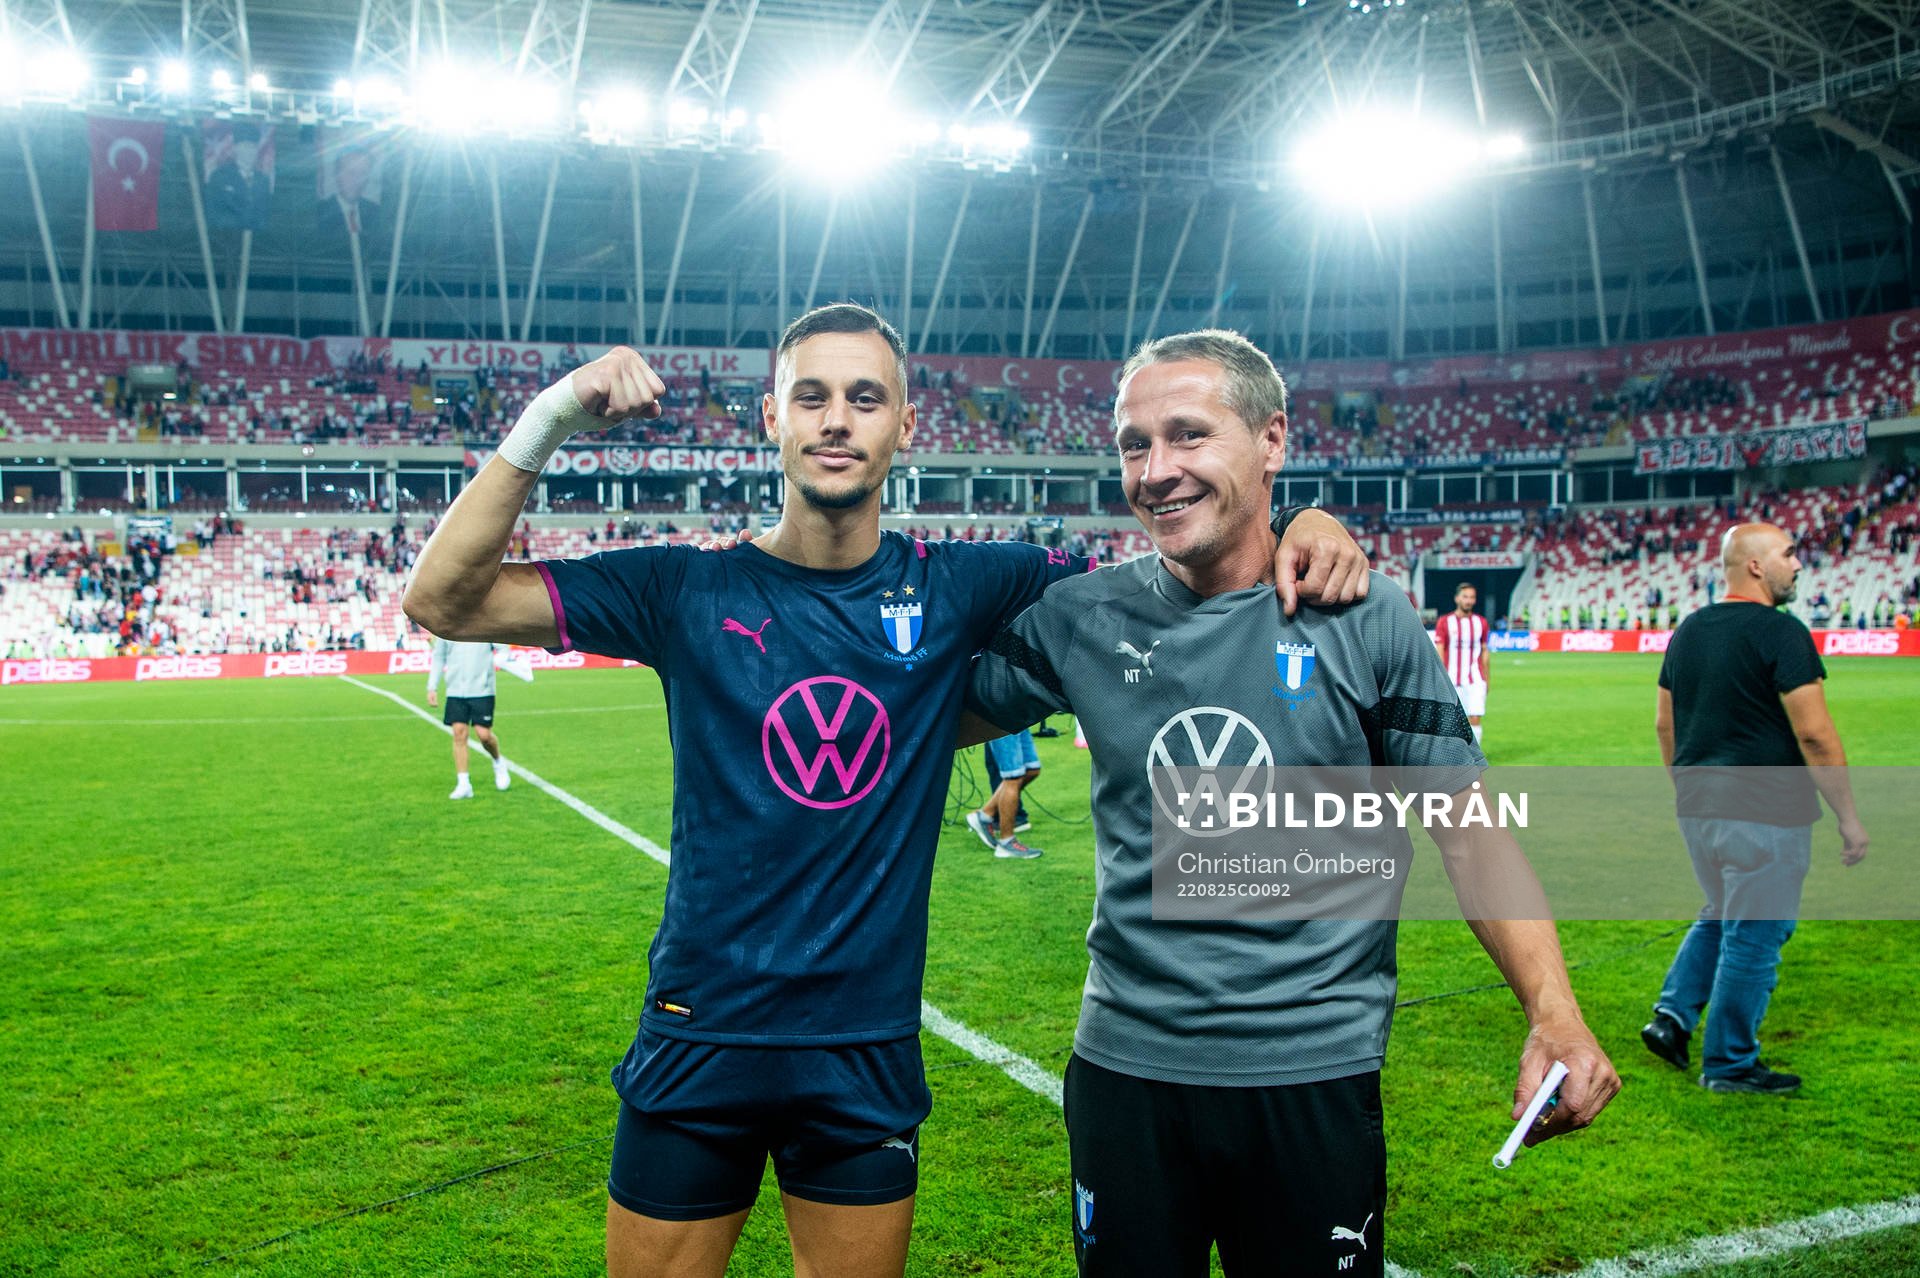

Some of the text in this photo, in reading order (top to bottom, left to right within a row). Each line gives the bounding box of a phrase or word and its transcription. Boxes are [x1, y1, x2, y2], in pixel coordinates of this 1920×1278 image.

[648, 351, 739, 376] NÇLİK
[1824, 629, 1899, 655] petlas
[2, 657, 91, 685] petlas
[136, 654, 222, 681] petlas
[265, 648, 347, 677] petlas
[1124, 669, 1140, 683] NT
[762, 675, 891, 810] VW
[1338, 1254, 1356, 1271] NT
